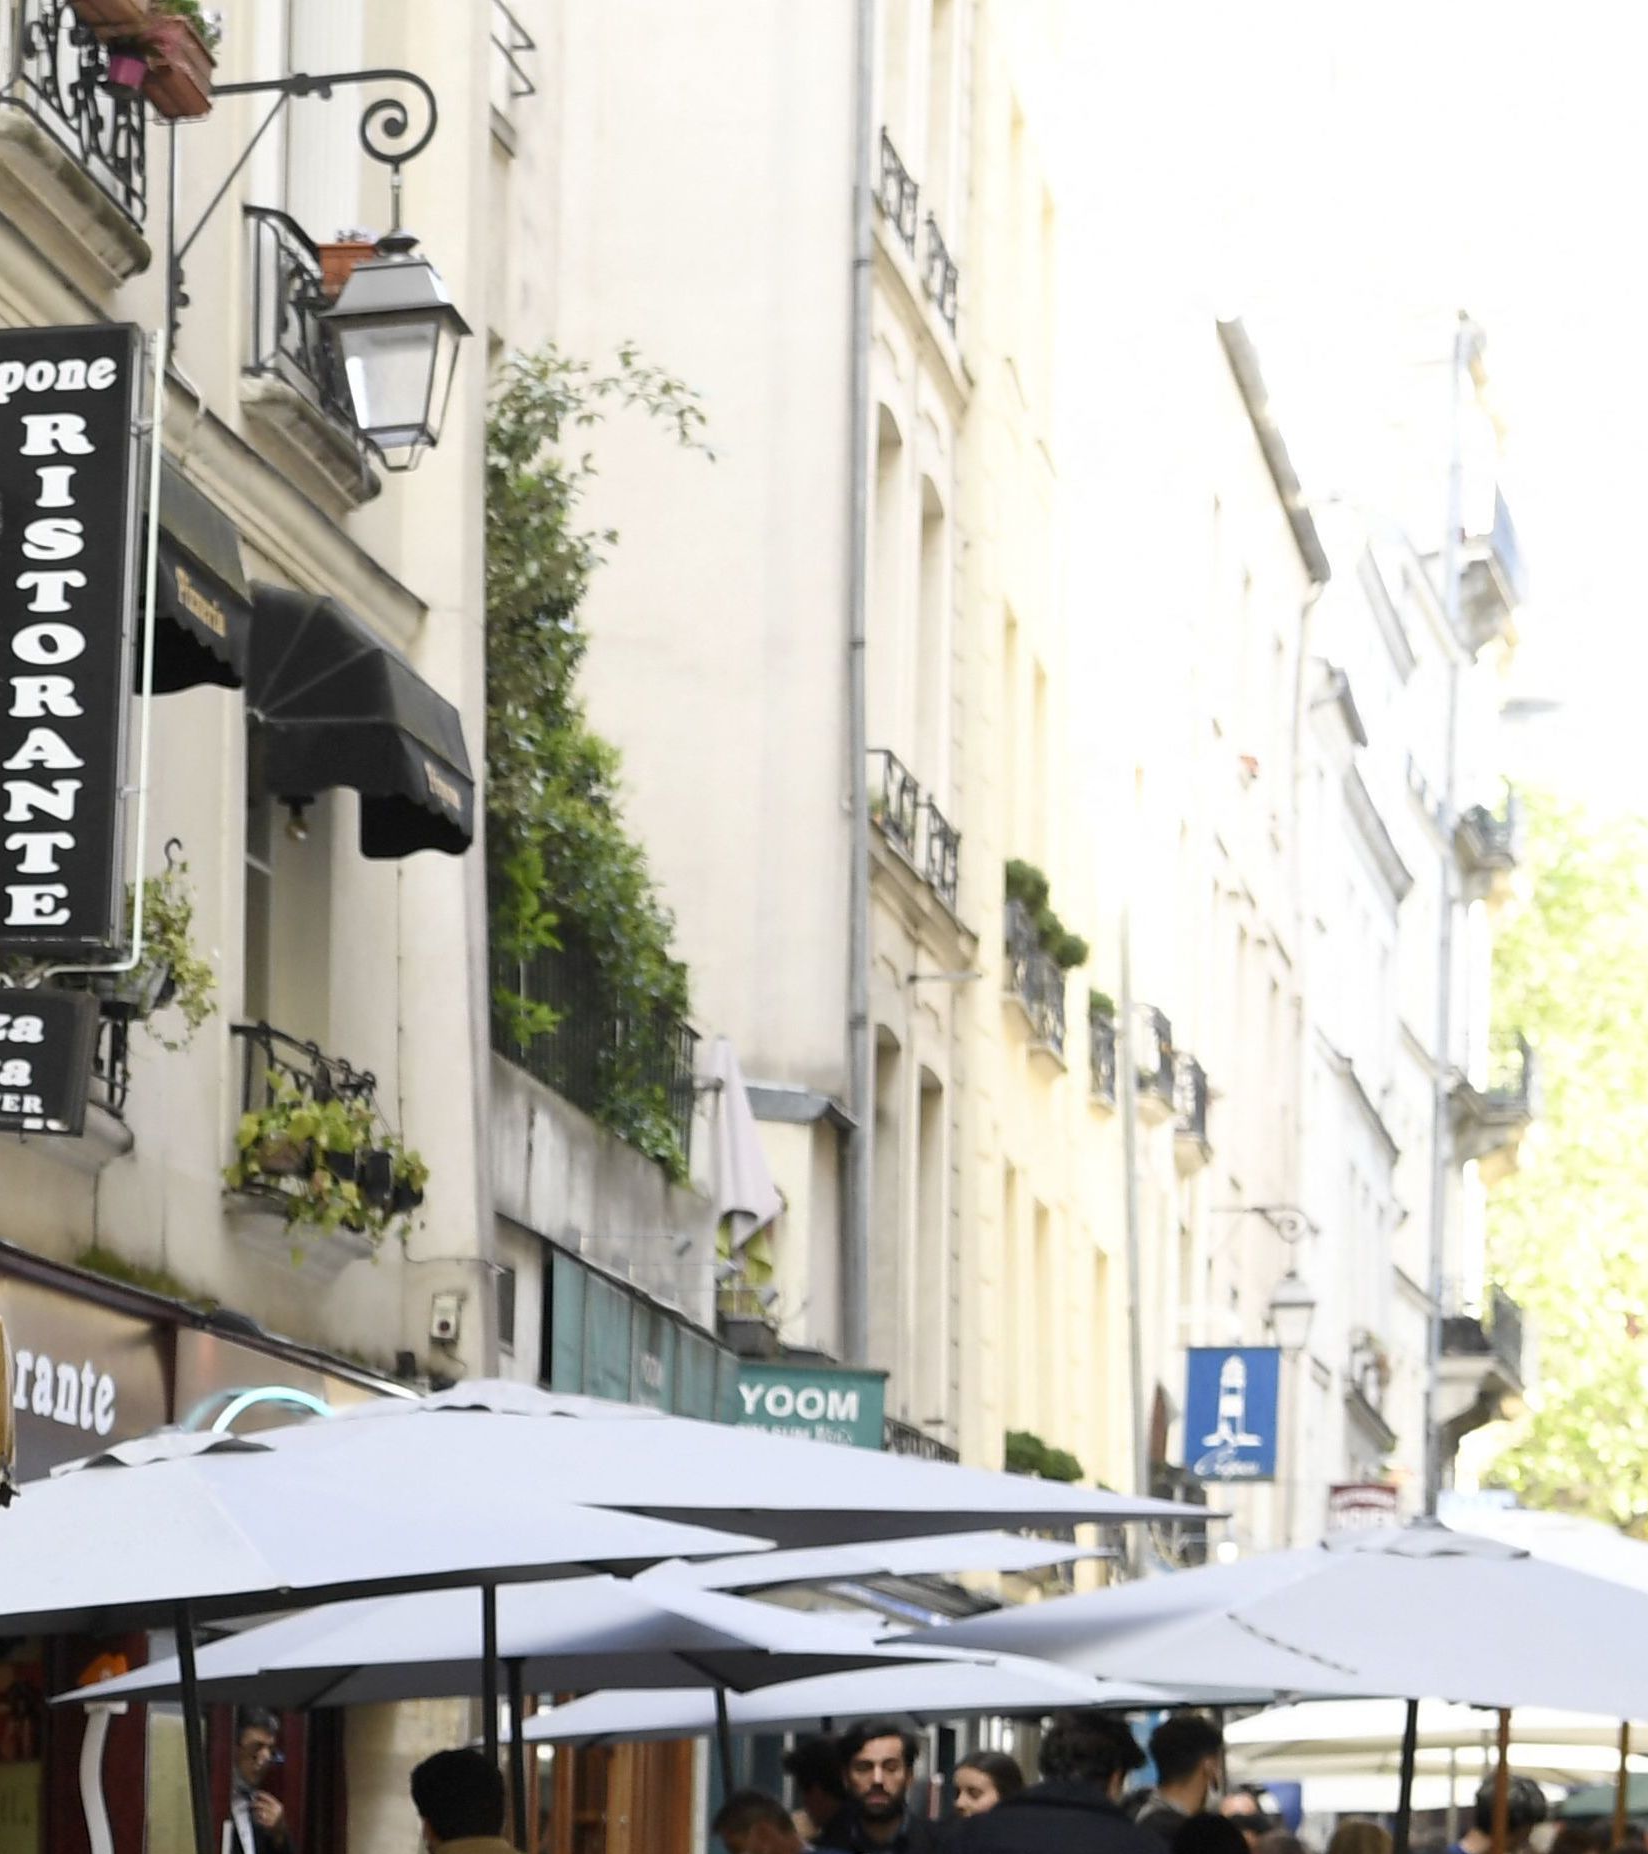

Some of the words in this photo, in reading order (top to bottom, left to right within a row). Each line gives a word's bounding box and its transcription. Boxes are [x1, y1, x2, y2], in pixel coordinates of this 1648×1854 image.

[2, 412, 96, 928] RISTORANTE
[12, 1349, 116, 1436] rante
[737, 1383, 860, 1422] YOOM
